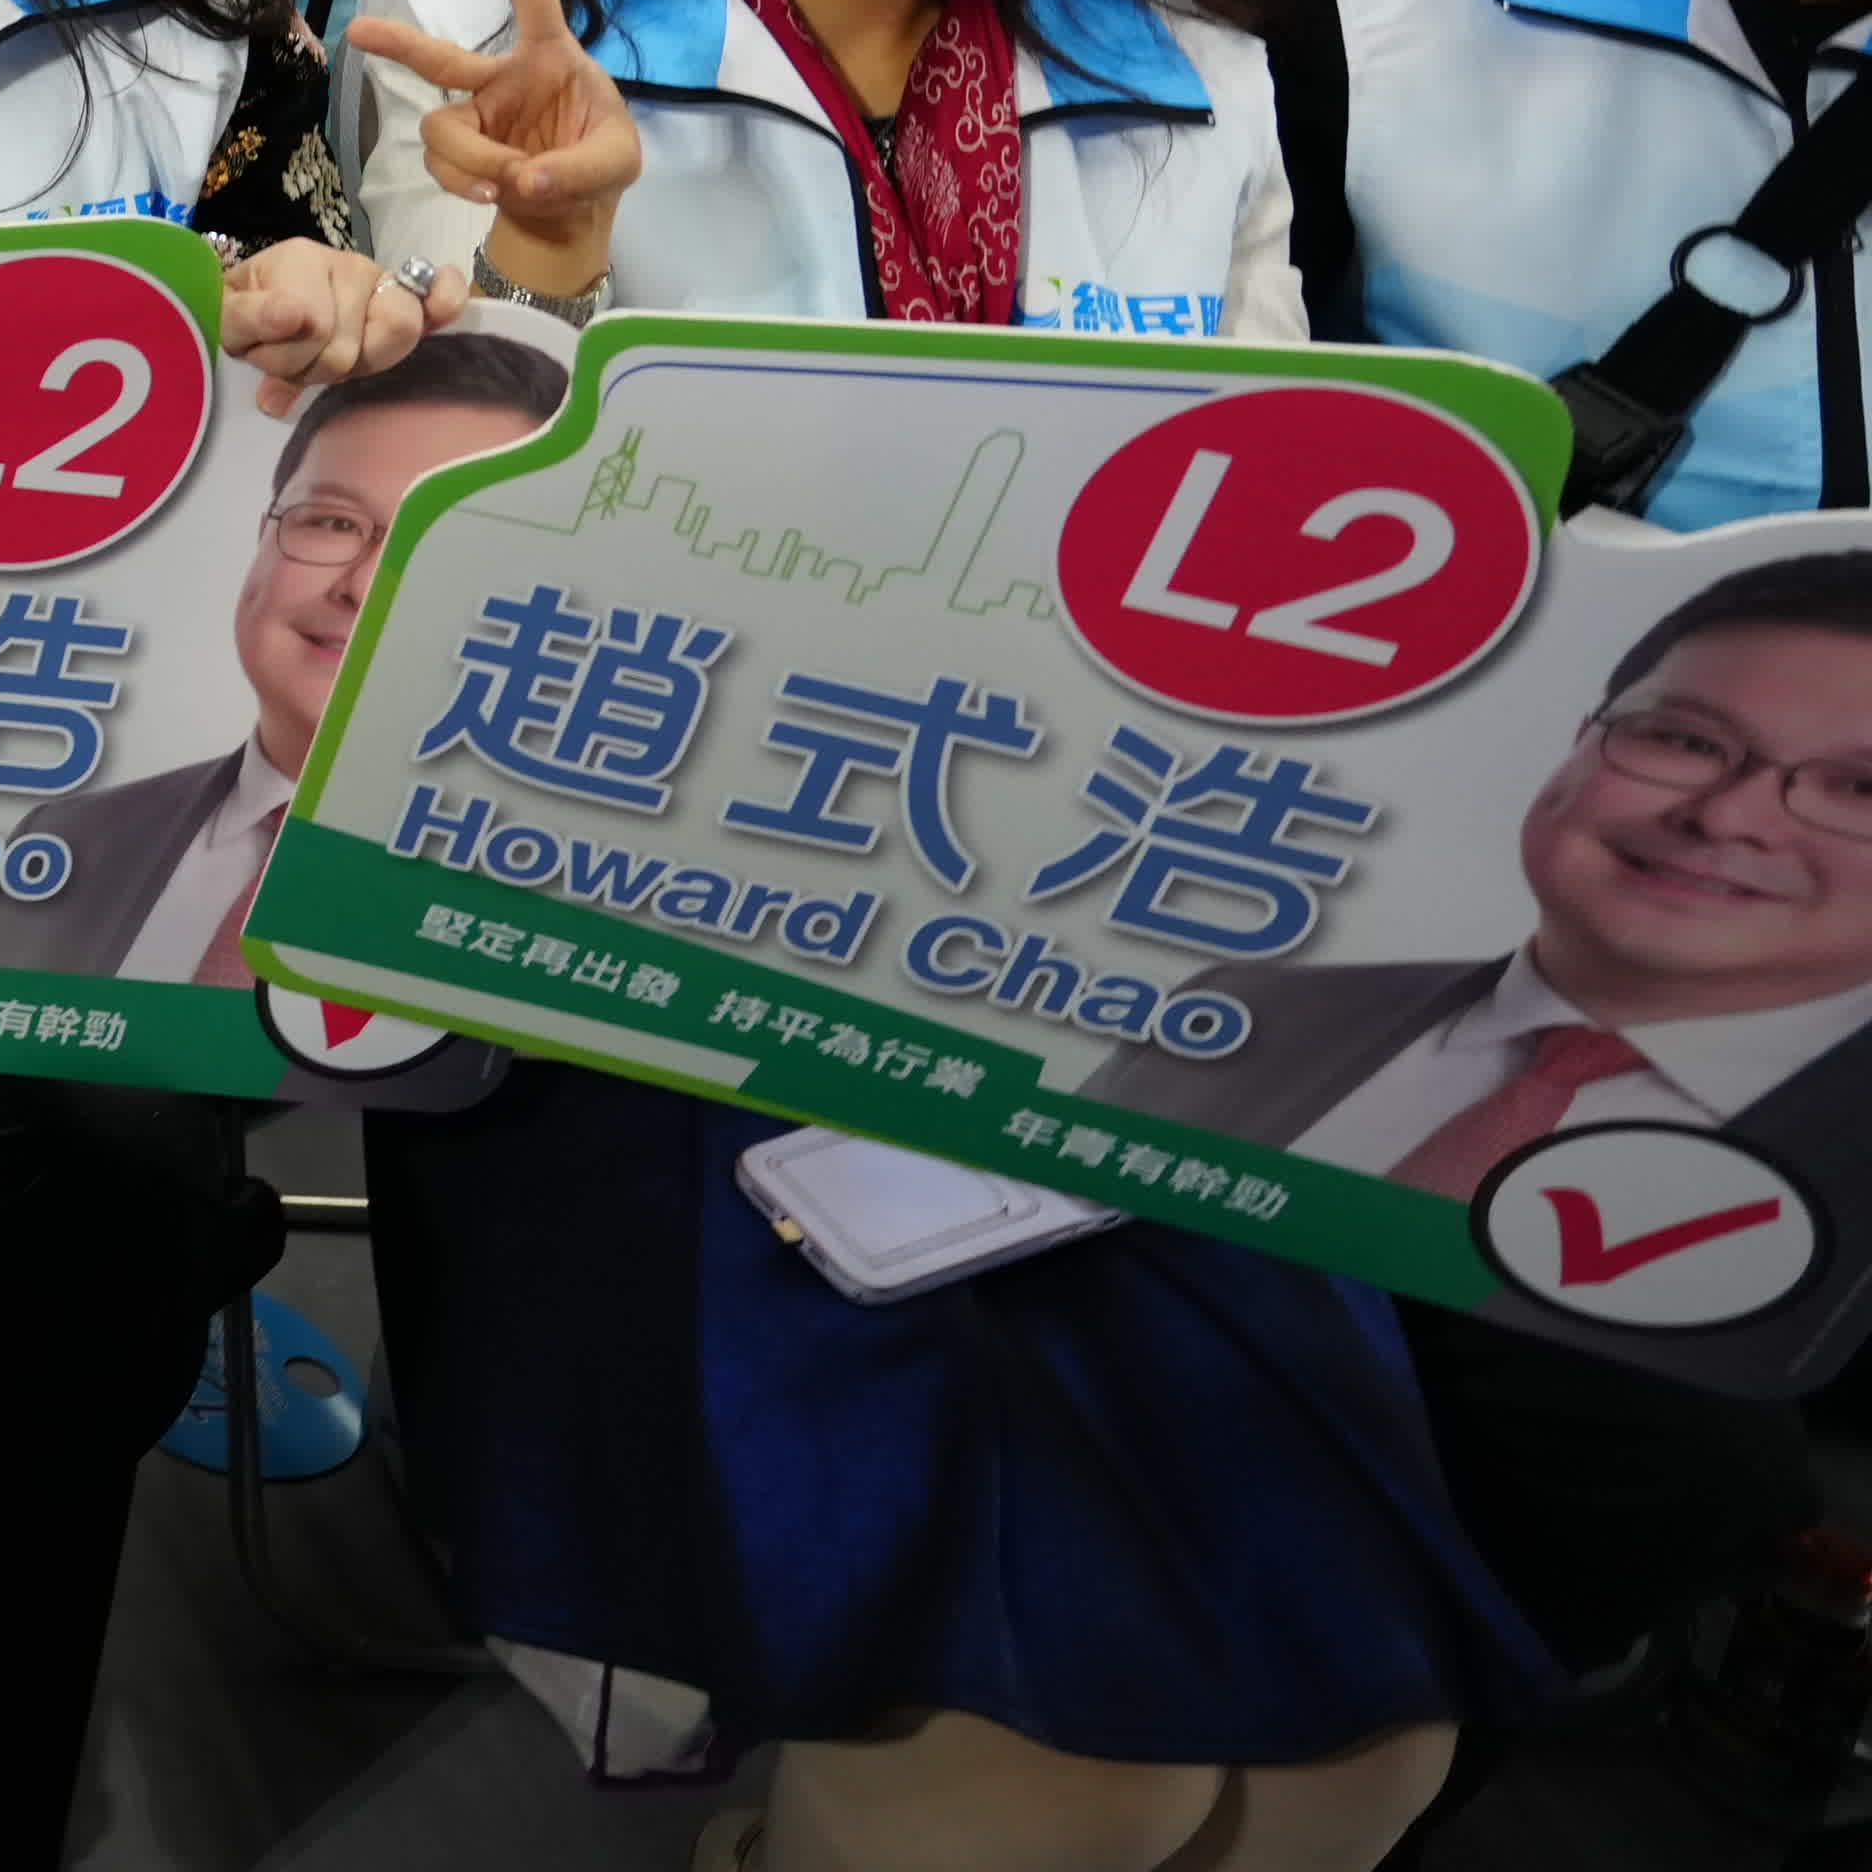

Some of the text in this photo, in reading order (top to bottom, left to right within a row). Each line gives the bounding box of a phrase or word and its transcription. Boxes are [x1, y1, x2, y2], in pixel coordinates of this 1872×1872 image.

[1117, 447, 1456, 671] L2
[414, 584, 1382, 955] 趙式浩
[388, 783, 1254, 1062] Howard Chao
[415, 903, 987, 1099] 堅定再出發 持平為行業
[1002, 1108, 1290, 1221] 年青有幹勁
